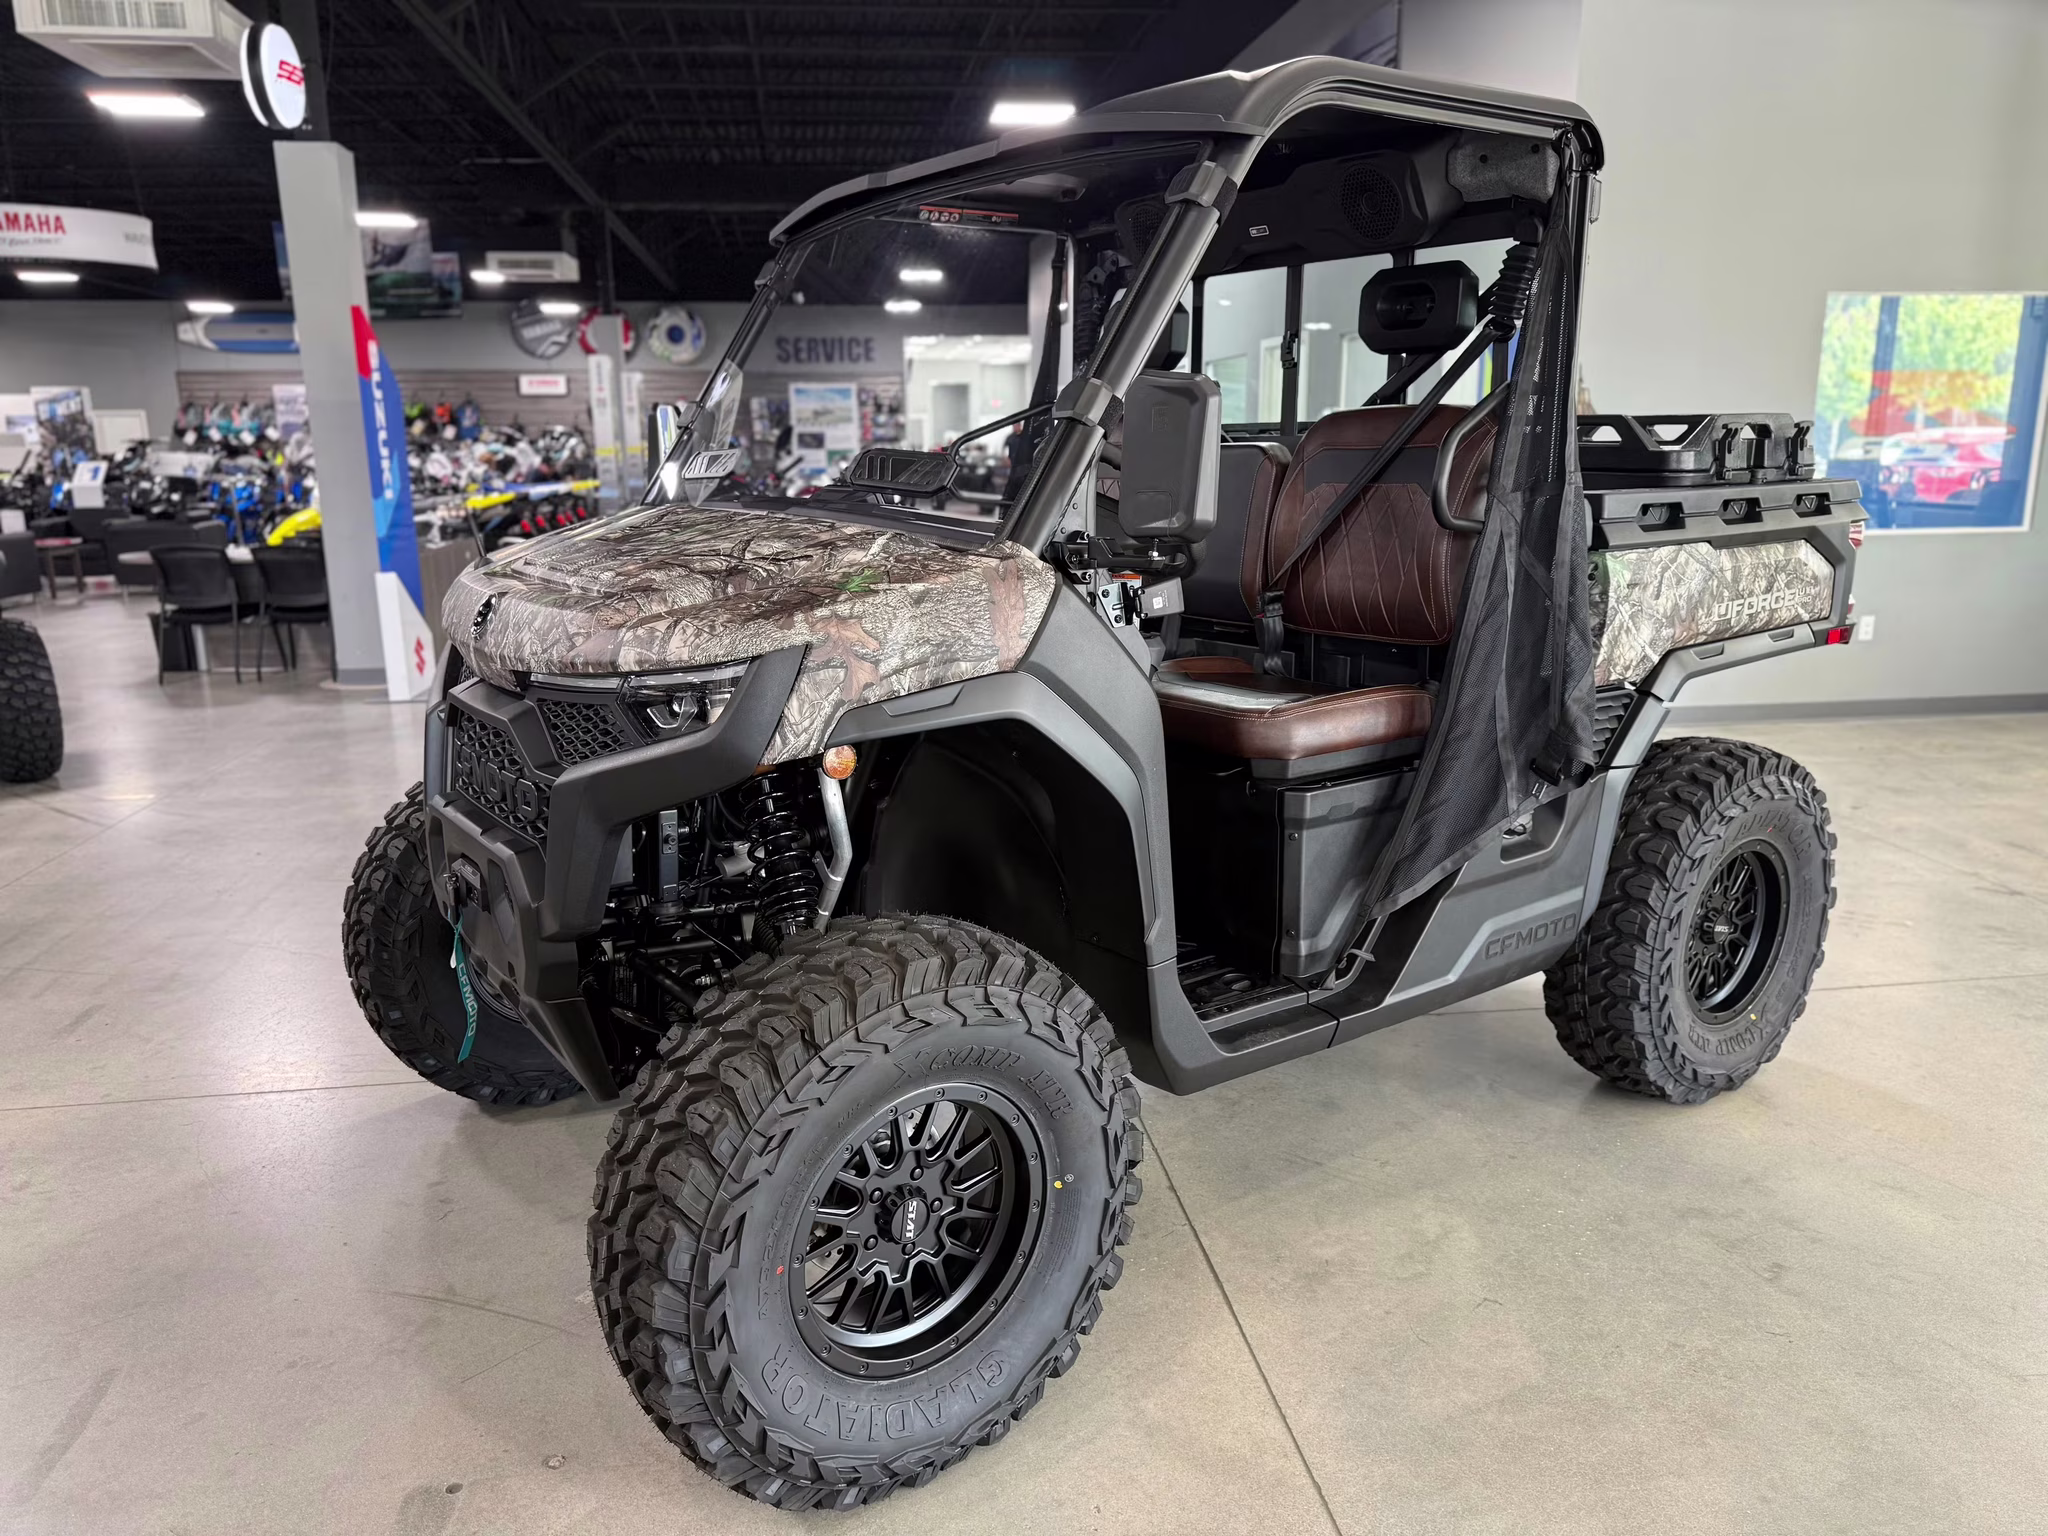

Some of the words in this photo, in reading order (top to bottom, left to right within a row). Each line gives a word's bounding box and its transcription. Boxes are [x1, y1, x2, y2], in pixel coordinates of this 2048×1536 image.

[775, 335, 876, 363] SERVICE
[367, 338, 395, 499] SUZUKI
[1485, 912, 1577, 960] CFMOTO
[457, 962, 478, 1037] CFMOTO
[762, 1343, 1009, 1442] GLADIATOR
